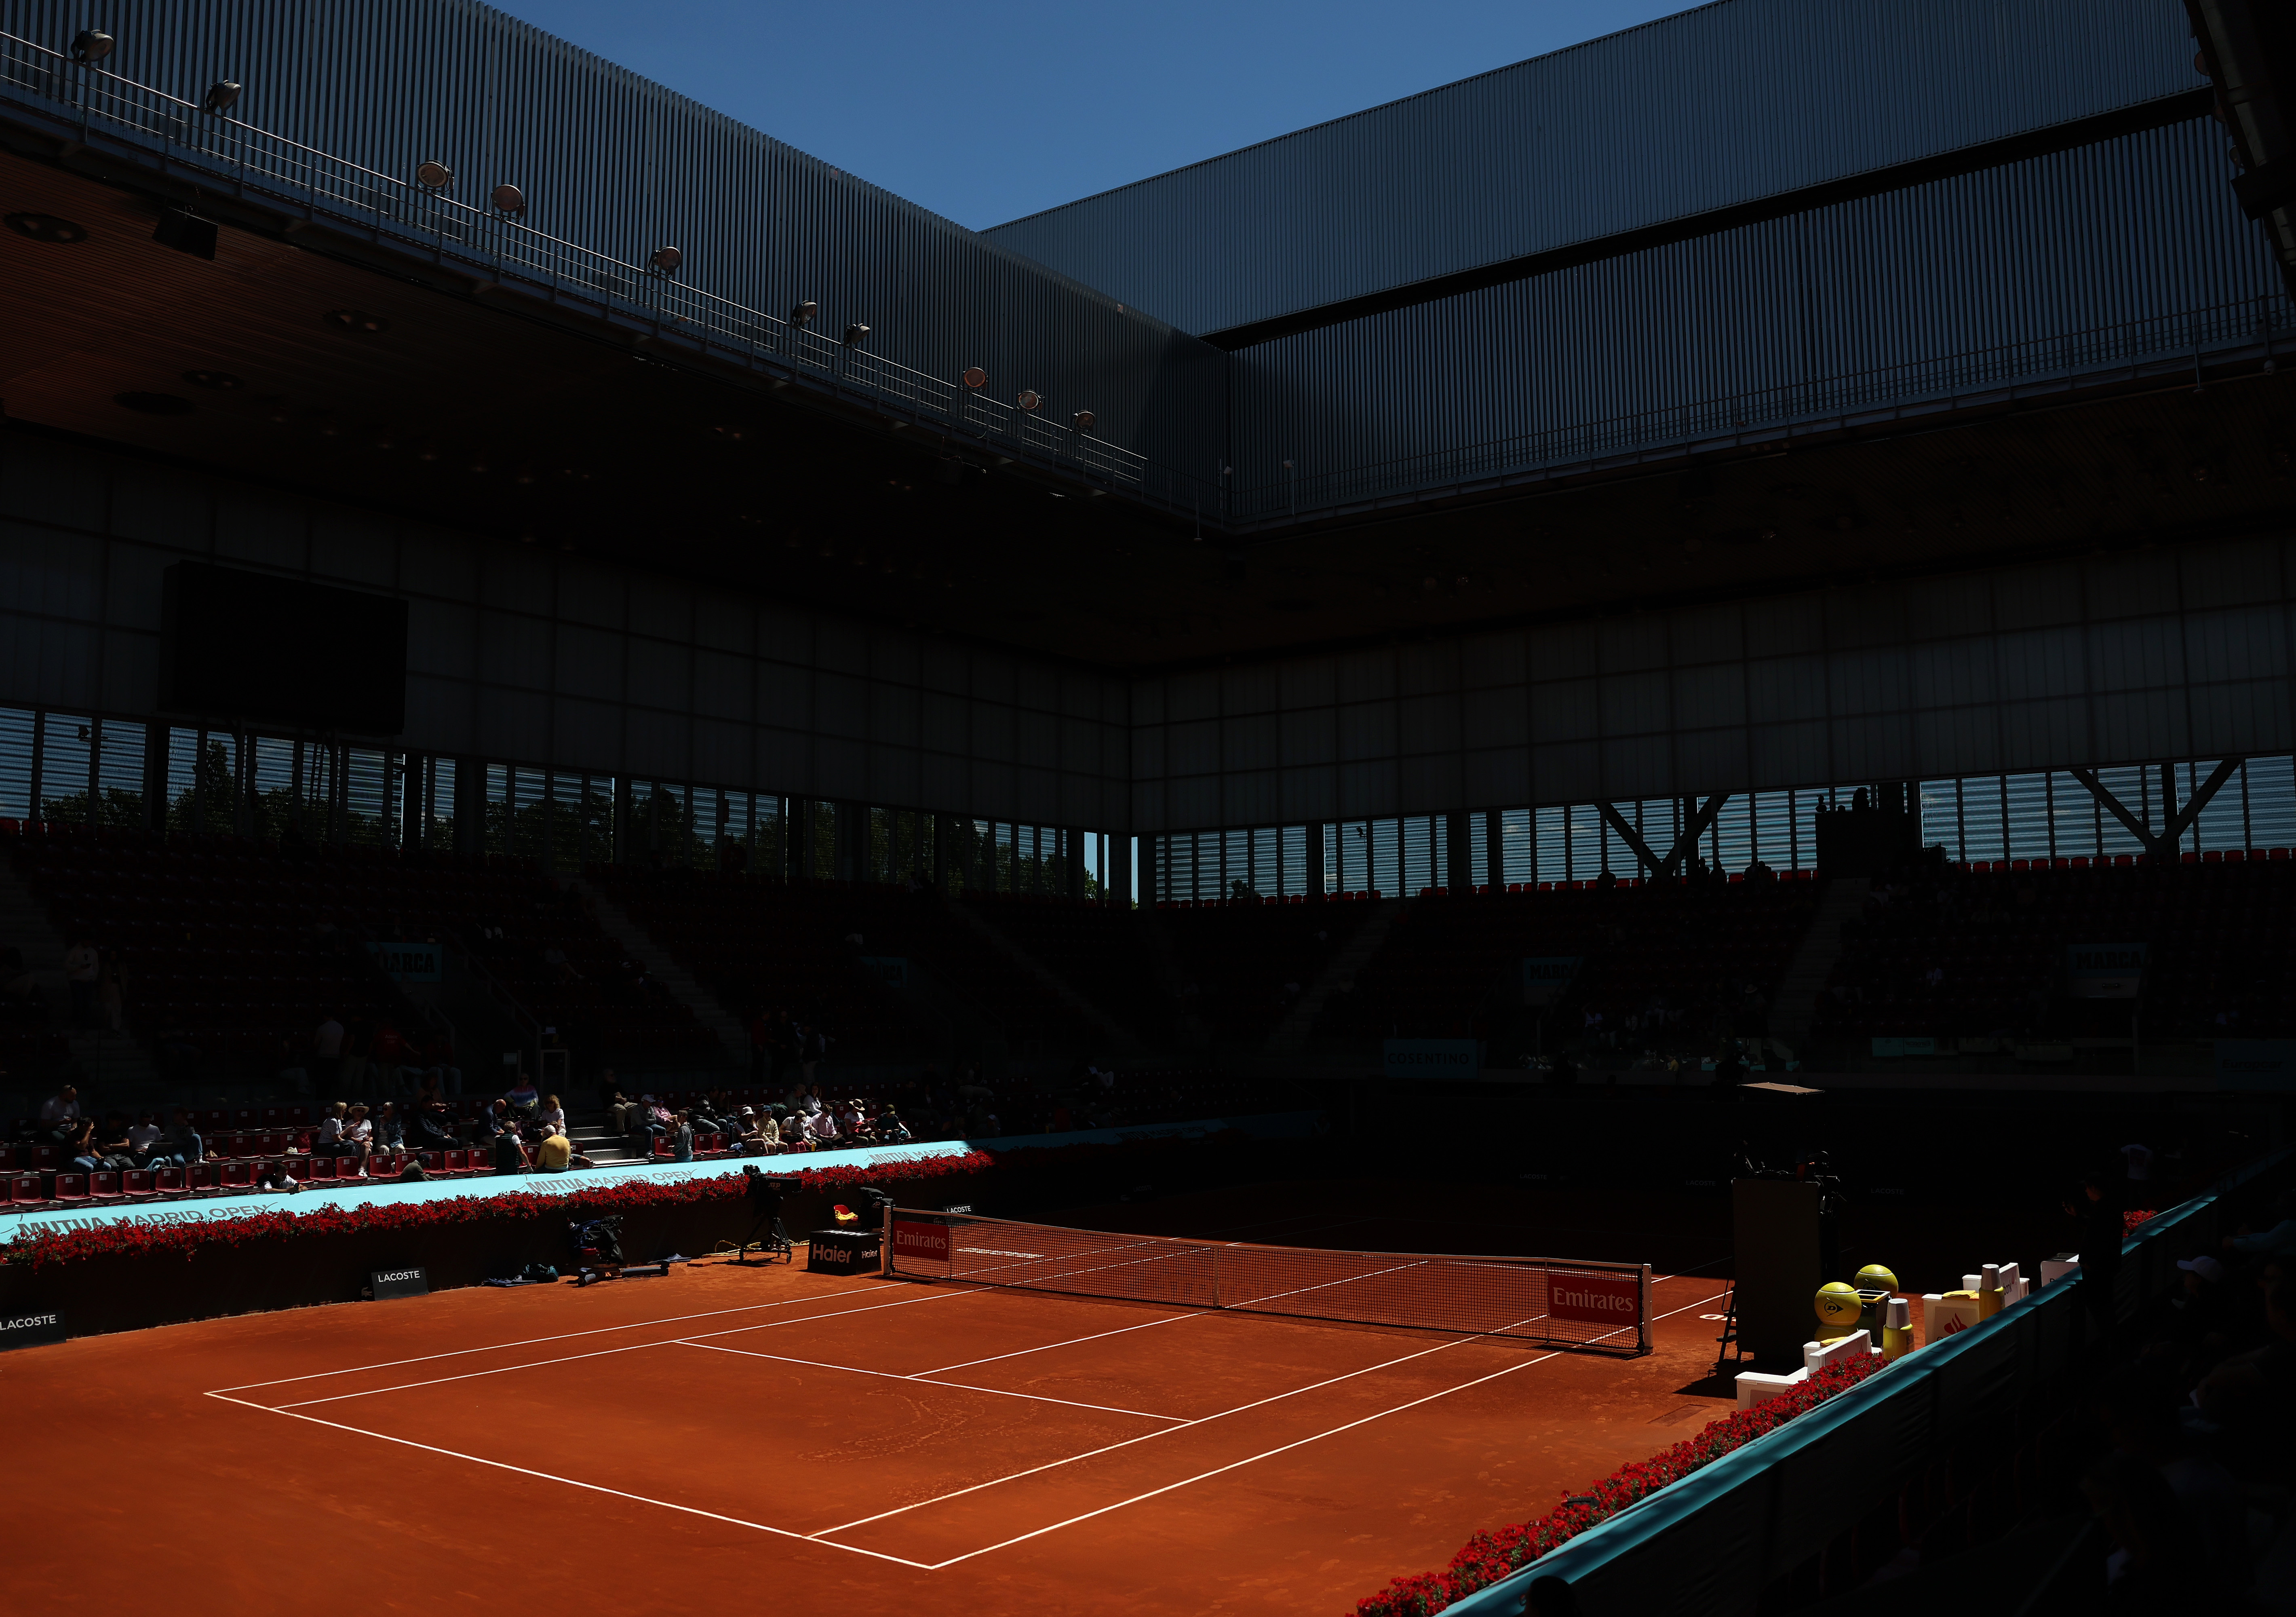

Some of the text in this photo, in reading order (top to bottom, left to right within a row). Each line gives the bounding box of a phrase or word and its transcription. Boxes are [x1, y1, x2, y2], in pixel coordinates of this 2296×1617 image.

[2076, 952, 2142, 970] MARCA
[1388, 1053, 1469, 1064] COSENTINO
[2222, 1059, 2283, 1071] Europcar
[869, 1151, 914, 1163] MUTUA
[912, 1148, 958, 1158] MADRID
[527, 1169, 693, 1192] MUTUA MADRID OPEN
[17, 1204, 269, 1236] MUTUA MADRID OPEN
[896, 1230, 946, 1250] Emirates
[812, 1243, 853, 1264] Haier
[861, 1250, 878, 1259] Haier
[378, 1270, 420, 1283] LACOSTE
[1553, 1287, 1634, 1312] Emirates
[0, 1314, 57, 1330] LACOSTE
